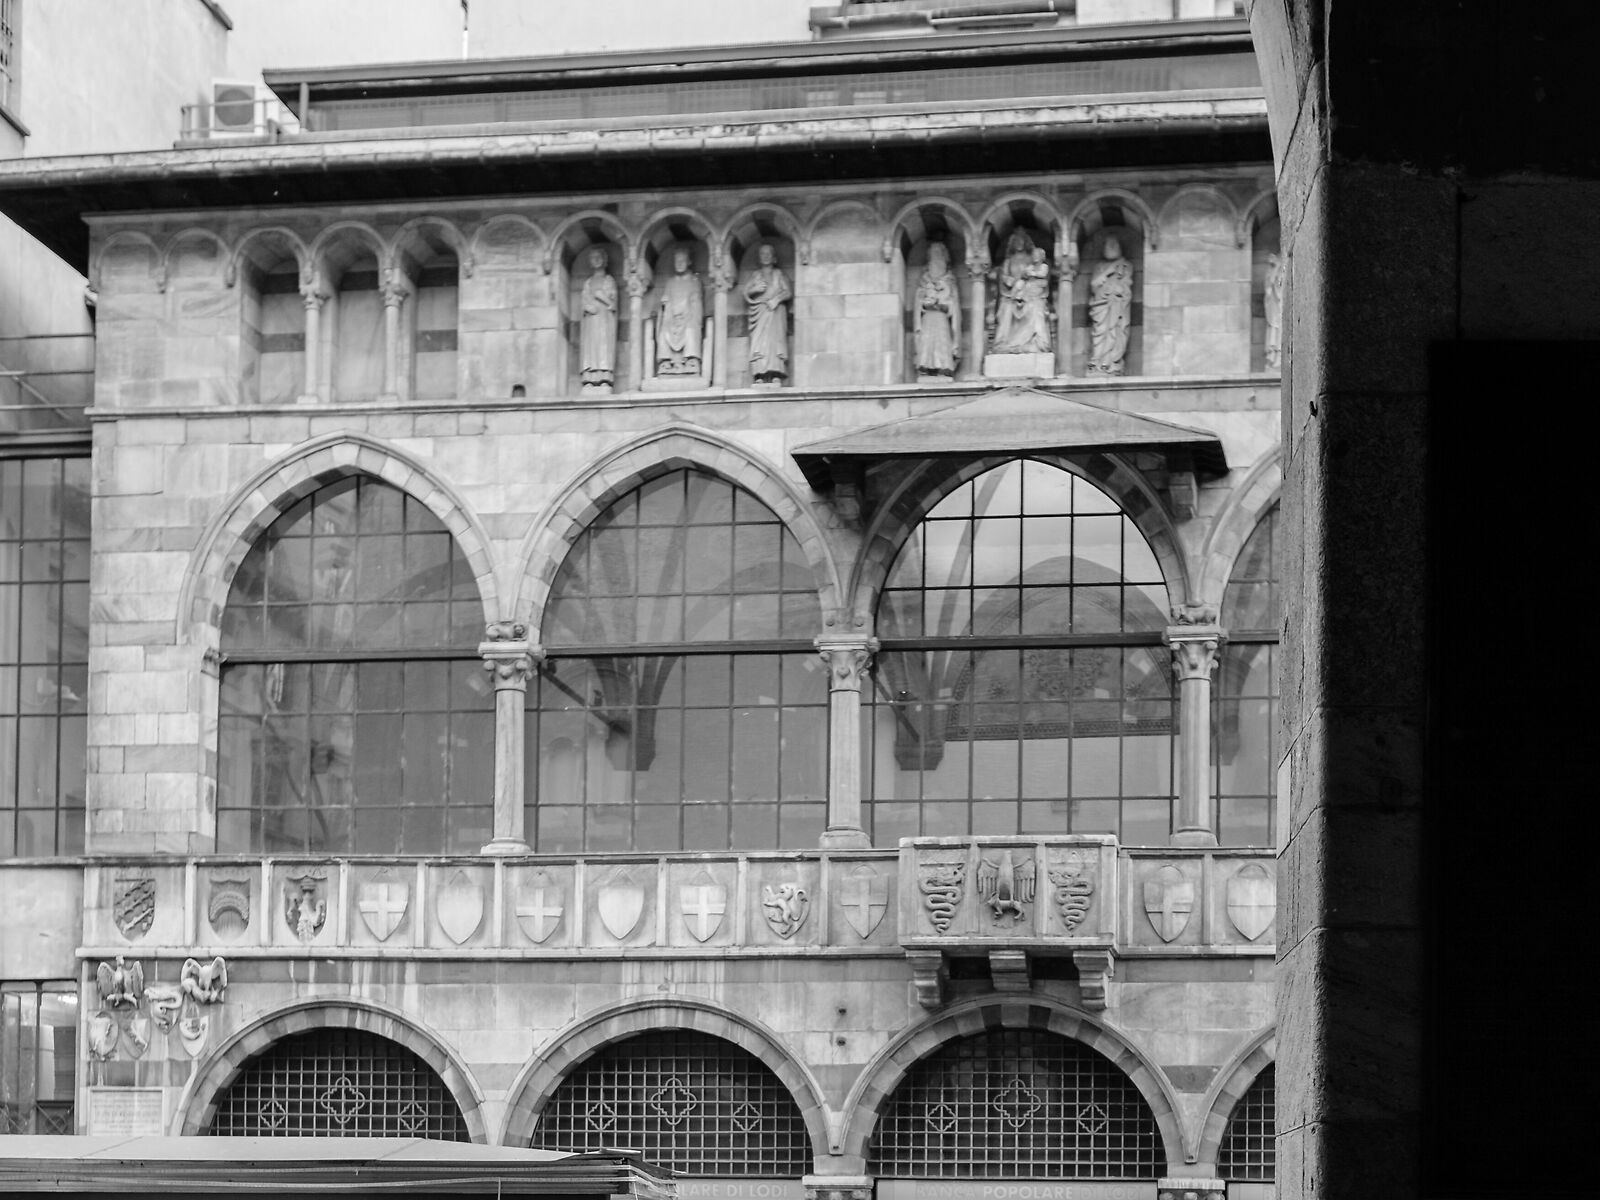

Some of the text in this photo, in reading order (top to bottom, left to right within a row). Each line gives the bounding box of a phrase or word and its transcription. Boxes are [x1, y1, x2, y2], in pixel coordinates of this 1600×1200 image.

[677, 1184, 788, 1198] LARE DI LODI
[983, 1186, 1073, 1200] POPOLARE
